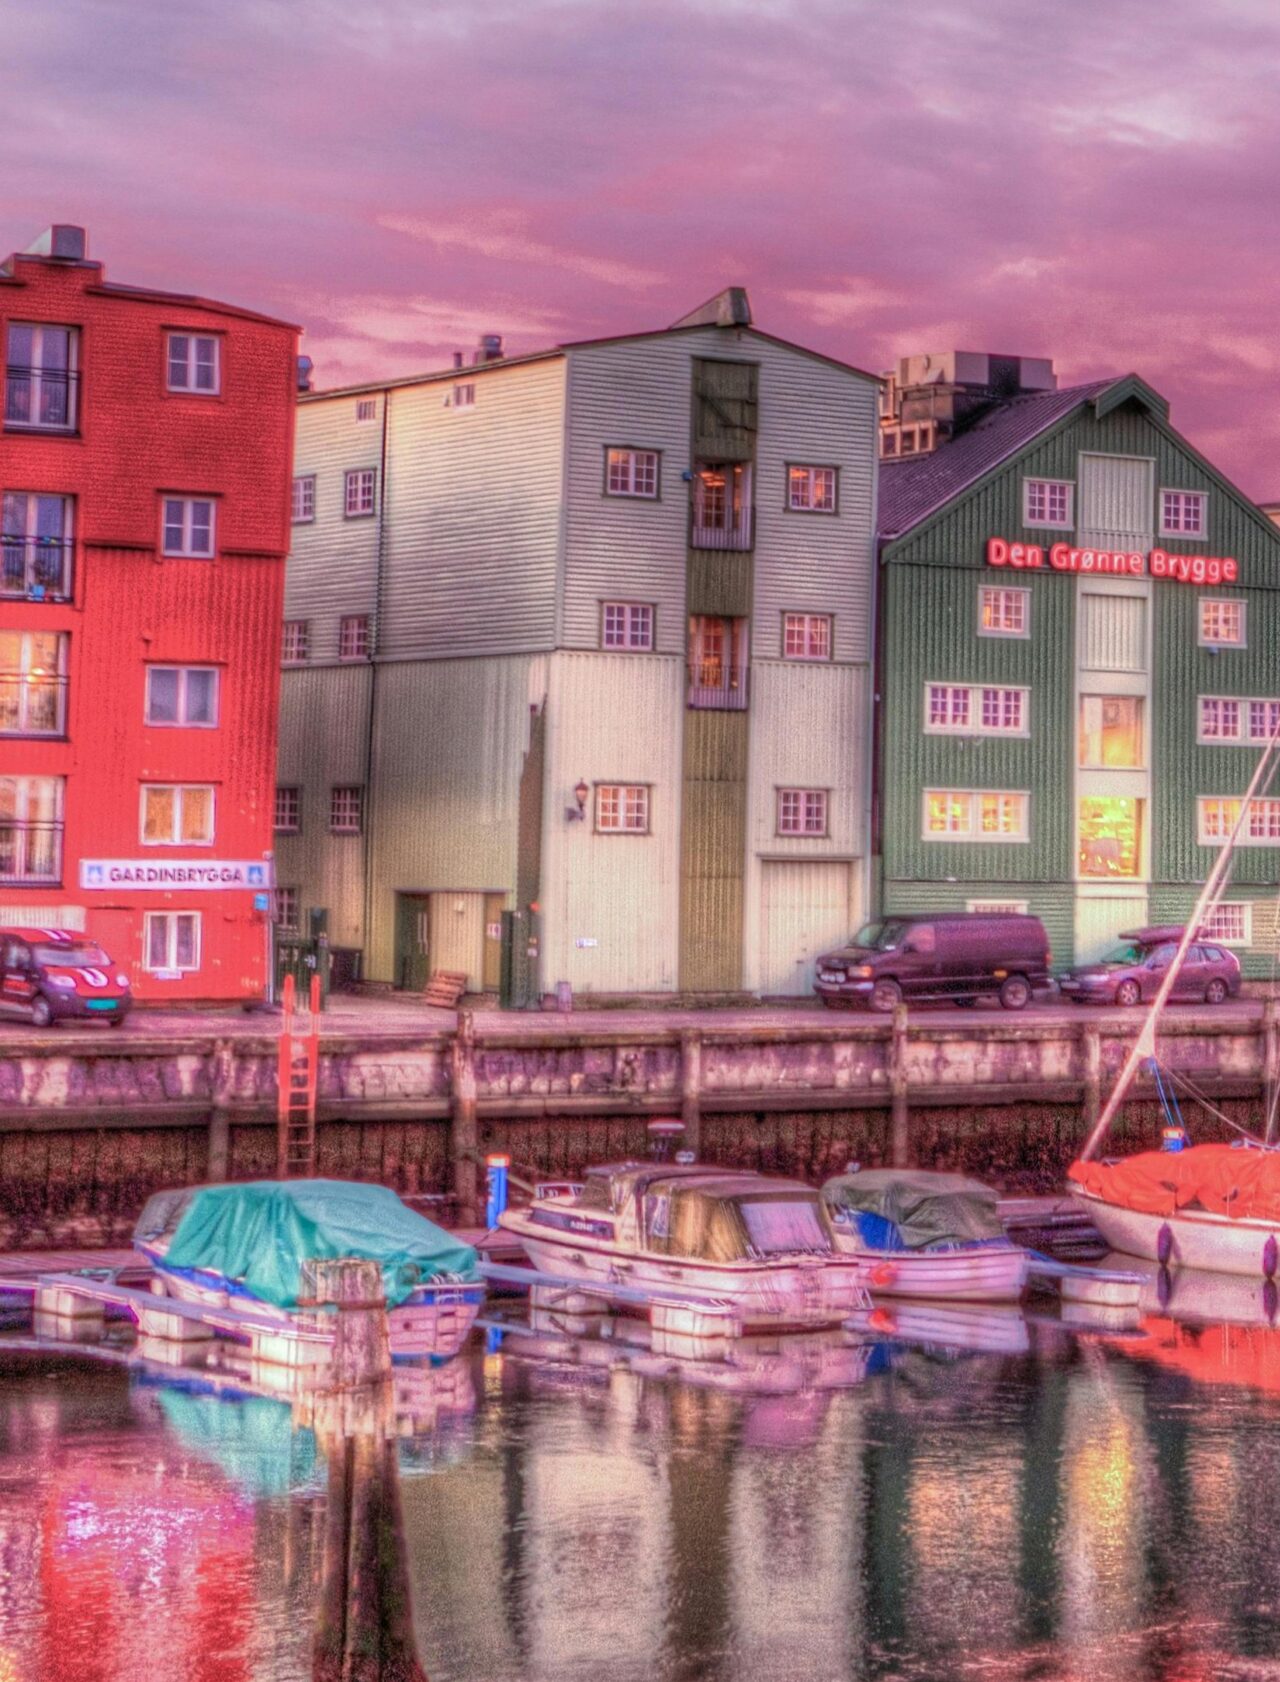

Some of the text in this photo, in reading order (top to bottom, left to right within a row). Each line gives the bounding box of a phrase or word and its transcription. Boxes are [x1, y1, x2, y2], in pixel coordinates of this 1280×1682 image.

[987, 537, 1239, 584] Den Grønne Brygge
[109, 867, 244, 883] GARDINBRYGGA
